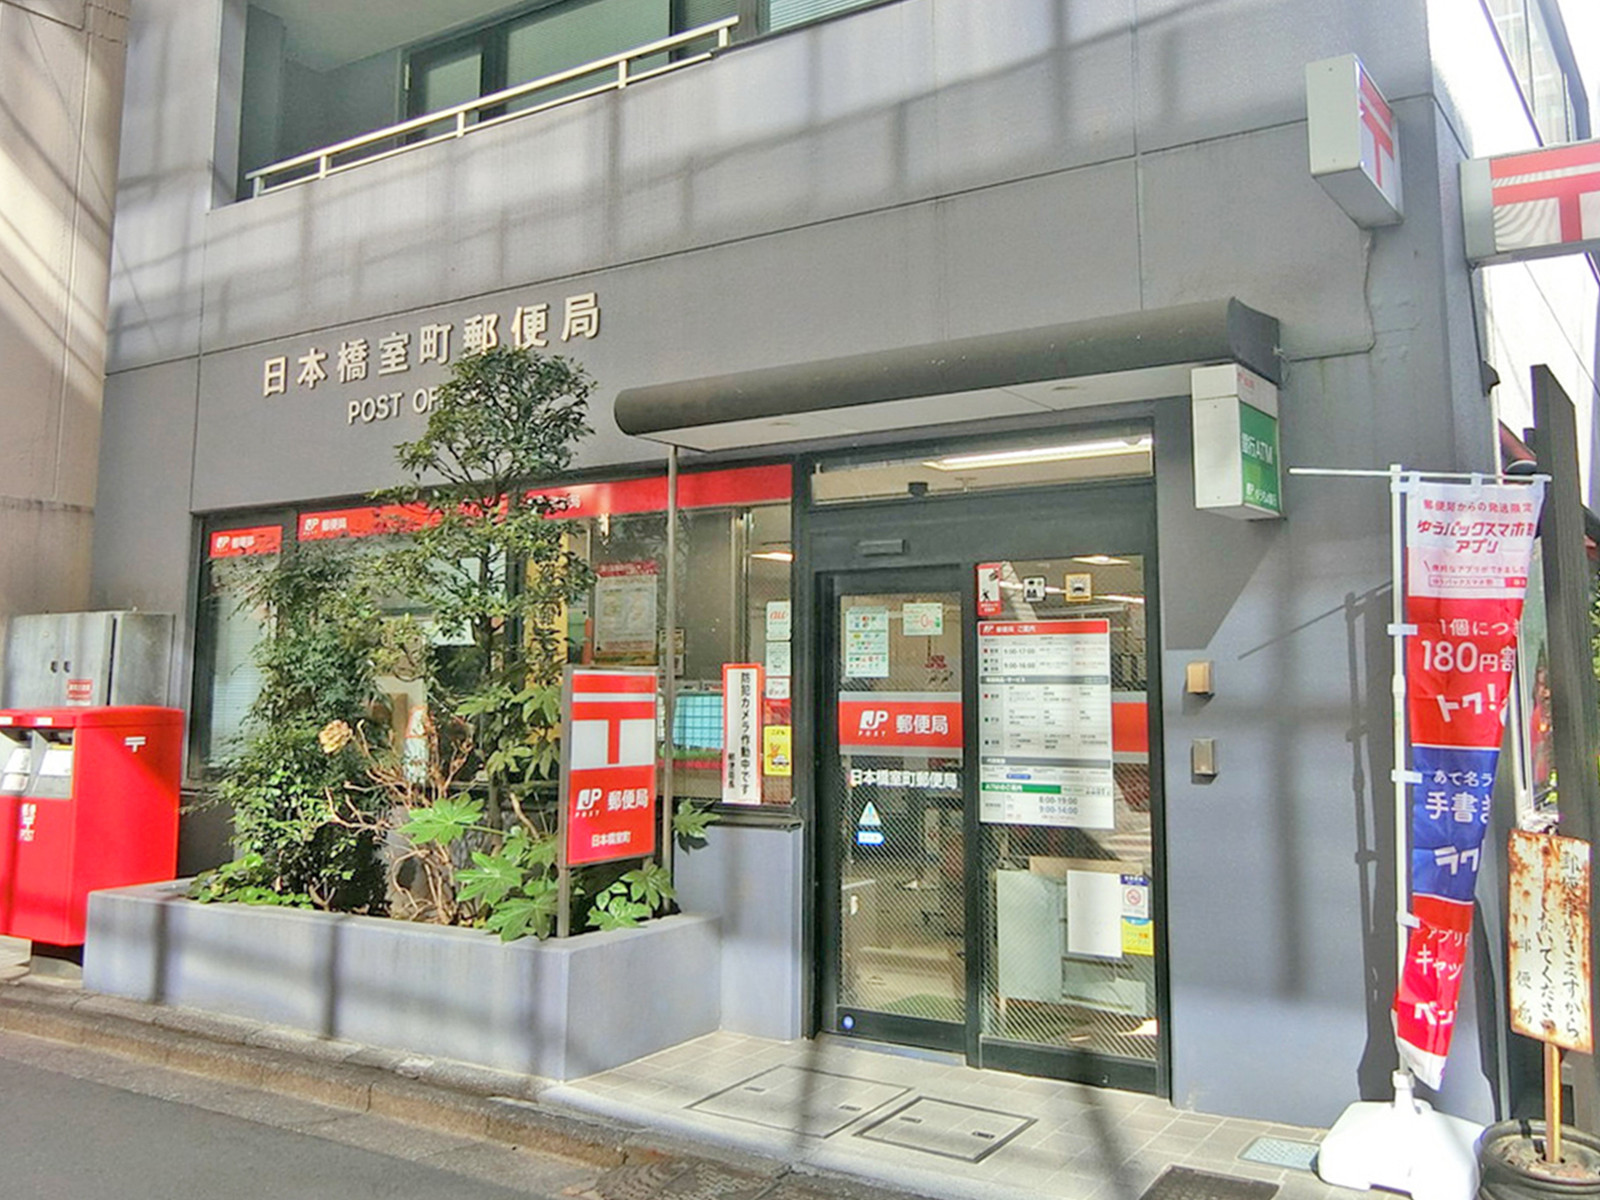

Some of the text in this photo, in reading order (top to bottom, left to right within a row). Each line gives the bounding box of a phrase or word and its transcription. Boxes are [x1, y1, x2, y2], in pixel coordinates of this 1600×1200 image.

[263, 292, 600, 397] 日本橋室町郵便局
[348, 392, 404, 425] POST
[1455, 539, 1499, 554] アプリ
[740, 672, 751, 795] 防犯カメラ作動中です
[896, 714, 949, 735] 郵便局
[850, 769, 958, 790] 日本橋室町郵便局
[607, 787, 649, 811] 郵便局
[1427, 927, 1469, 947] アプリ
